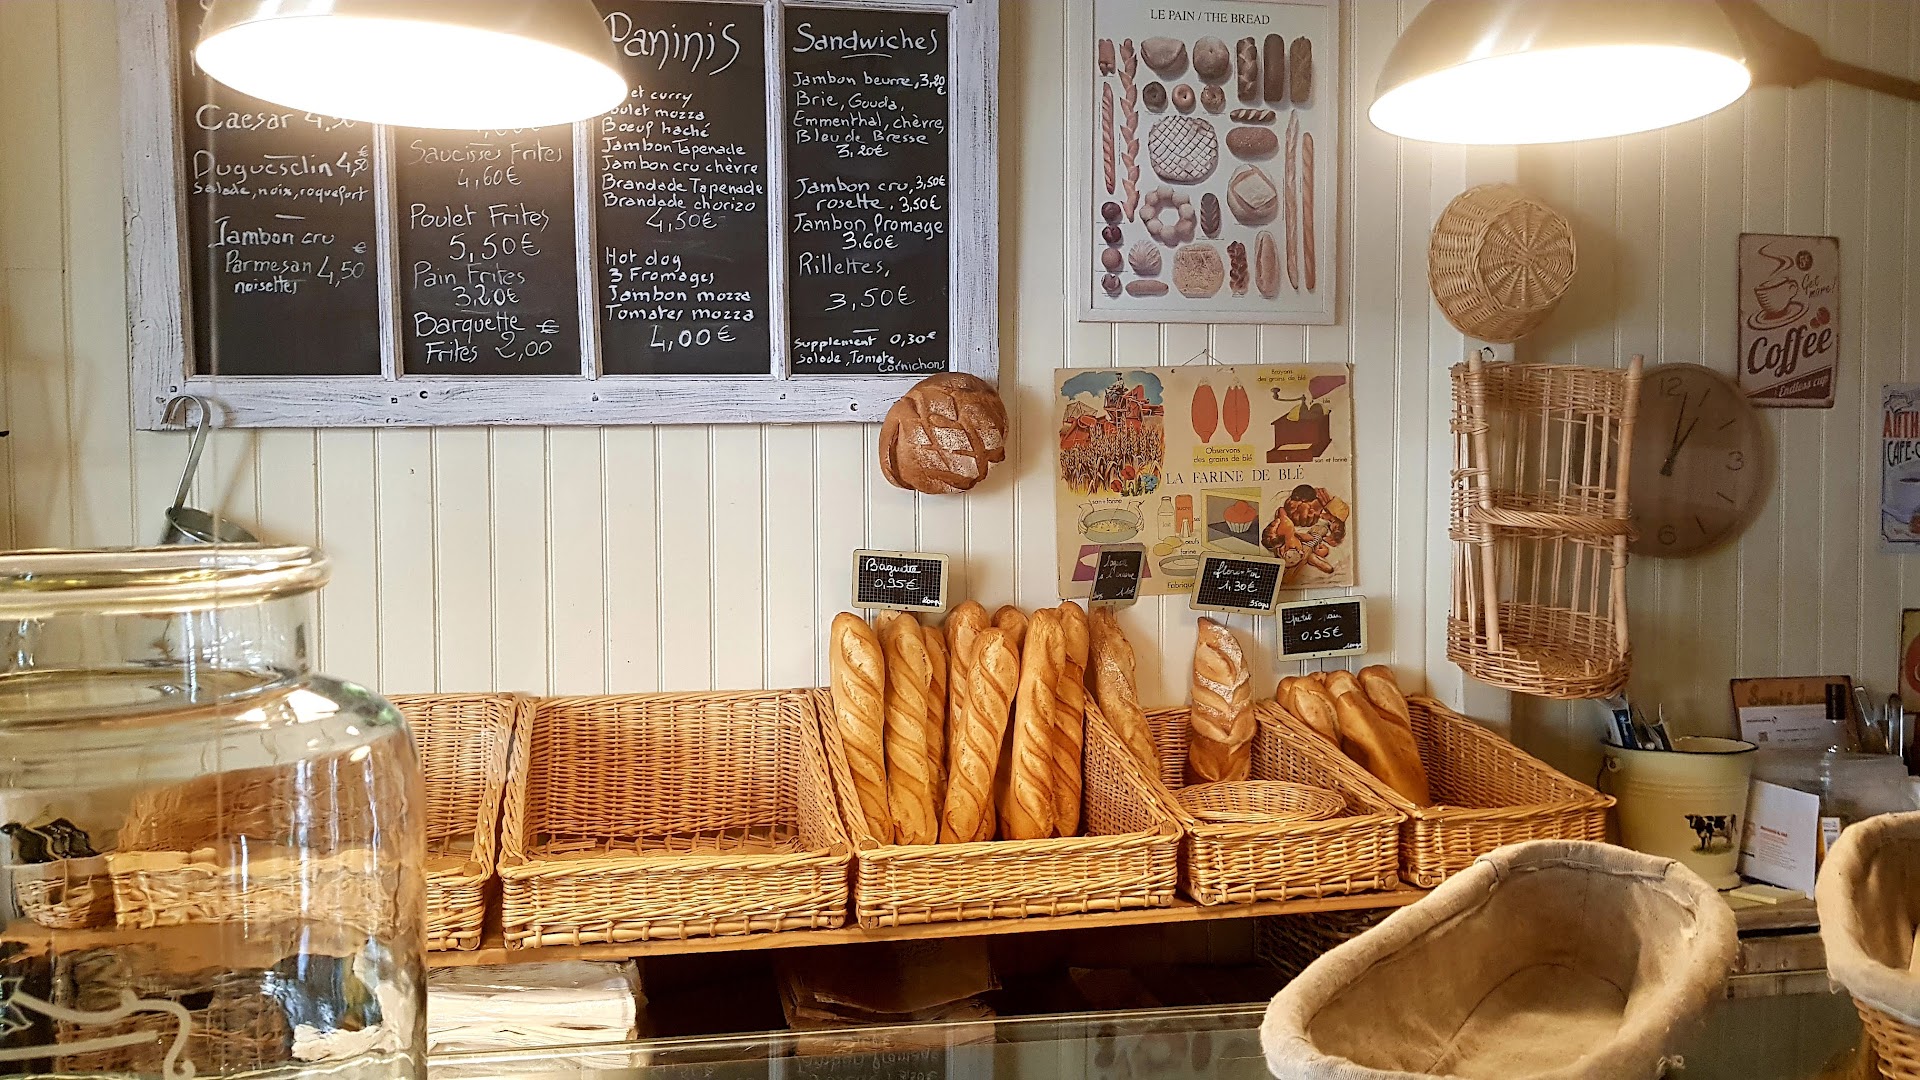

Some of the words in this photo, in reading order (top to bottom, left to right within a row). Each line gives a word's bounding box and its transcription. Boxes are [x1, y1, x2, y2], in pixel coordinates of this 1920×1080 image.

[1150, 9, 1166, 20] LE
[1169, 10, 1195, 21] PAIN
[1204, 11, 1228, 23] THE
[1231, 13, 1270, 25] BREAD
[792, 23, 938, 55] Sandwiches
[792, 71, 857, 87] Jambon
[864, 71, 920, 89] beurre,
[650, 92, 693, 108] curry
[796, 90, 845, 111] Brie,
[848, 93, 905, 112] Gouda,
[195, 104, 294, 131] Caesar
[655, 110, 705, 121] mozza
[793, 110, 889, 131] Emmenthal,
[661, 122, 711, 138] haché
[796, 129, 840, 144] Bleu
[845, 129, 865, 144] de
[873, 131, 929, 144] Bresse
[408, 139, 501, 165] Saucisses
[510, 140, 565, 164] Frites
[601, 136, 673, 153] Jambon
[672, 139, 746, 160] Tapenade
[836, 144, 889, 158] 3,20€
[193, 150, 333, 185] Duguesclin
[601, 155, 669, 171] Jambon
[673, 163, 700, 172] cru
[705, 157, 758, 174] chèvre
[457, 165, 523, 189] 4,60€
[602, 173, 687, 192] Brandade
[689, 178, 764, 199] Tapenade
[794, 177, 870, 199] Jambon
[878, 182, 914, 194] cru,
[915, 175, 946, 189] 3,50€
[603, 191, 687, 208] Brandade
[693, 195, 756, 212] chorizo
[899, 195, 942, 212] 3,50€
[409, 203, 477, 230] Poulet
[488, 202, 550, 232] Frites
[645, 207, 718, 233] 4,50€
[793, 213, 867, 233] Jambon
[207, 216, 294, 247] Jambon
[302, 232, 335, 244] cru
[842, 231, 899, 250] 3,60€
[449, 232, 541, 262] 5,50€
[225, 249, 312, 274] Parmesan
[605, 246, 637, 266] Hot
[645, 249, 682, 272] dog
[413, 260, 457, 289] Pain
[467, 262, 525, 285] Frites
[609, 268, 623, 284] 3
[629, 266, 715, 289] Fromages
[452, 284, 520, 307] 3,20€
[609, 284, 687, 302] Jambon
[697, 291, 751, 302] mozza
[824, 285, 916, 311] 3,50€
[605, 303, 683, 321] Tomates
[692, 308, 755, 322] mozza
[414, 311, 525, 343] Barquette
[889, 331, 937, 347] 0,30€
[425, 338, 478, 364] Frites
[1747, 324, 1833, 378] Coffee
[1658, 376, 1683, 398] 12
[1778, 379, 1812, 398] Endless
[1812, 374, 1829, 388] cup
[1205, 446, 1240, 454] Observons
[1208, 456, 1228, 464] grains
[1725, 450, 1744, 471] 3
[1166, 472, 1184, 485] LA
[1192, 470, 1244, 484] FARINE
[1252, 468, 1271, 482] DE
[1278, 464, 1305, 481] BLÉ
[1657, 524, 1677, 545] 6
[874, 578, 920, 590] 0,95€
[1218, 581, 1258, 593] 1,30€
[1301, 626, 1344, 641] 0,55€
